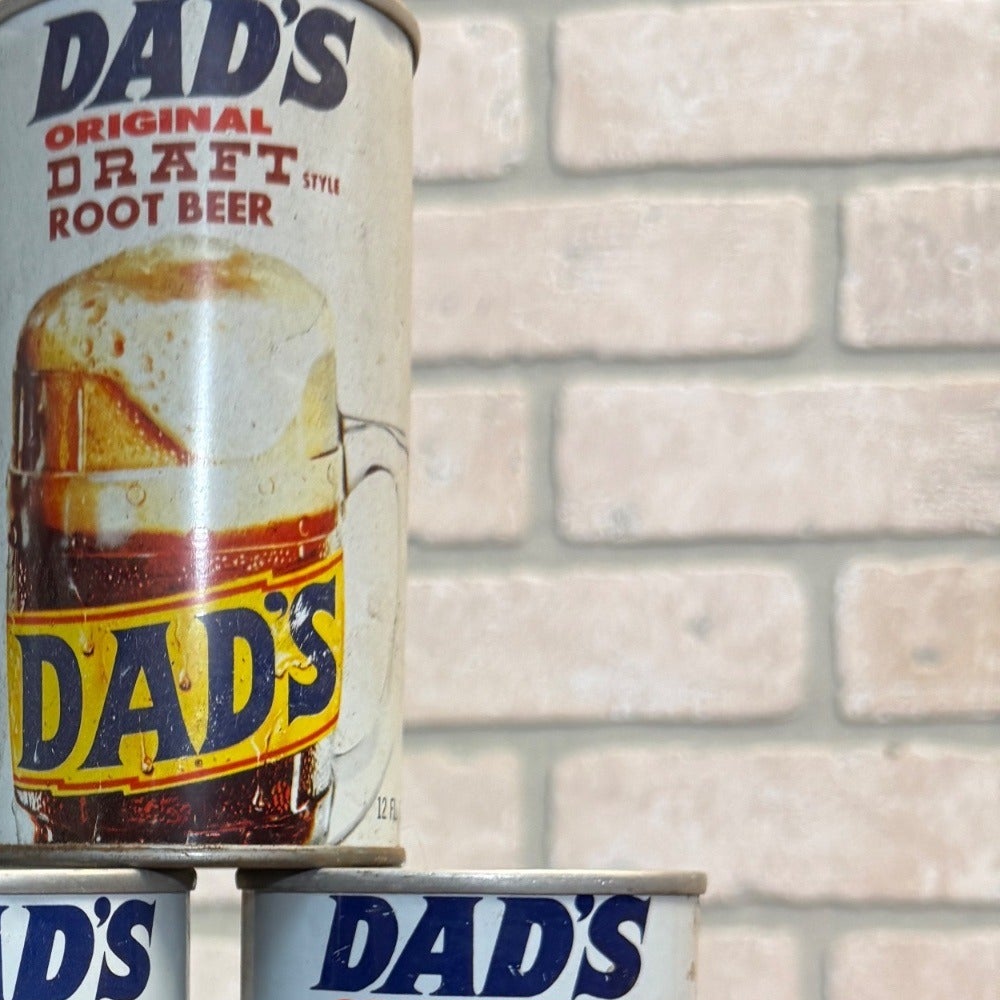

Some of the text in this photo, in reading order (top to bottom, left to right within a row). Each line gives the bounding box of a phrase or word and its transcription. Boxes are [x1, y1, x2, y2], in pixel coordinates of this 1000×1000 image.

[27, 0, 356, 126] DAD'S
[45, 106, 272, 151] ORIGINAL
[47, 141, 340, 199] DRAFT STYLE
[49, 190, 274, 242] ROOT BEER
[15, 575, 338, 770] DAD'S
[377, 796, 387, 820] 12
[310, 894, 651, 1000] DAD'S
